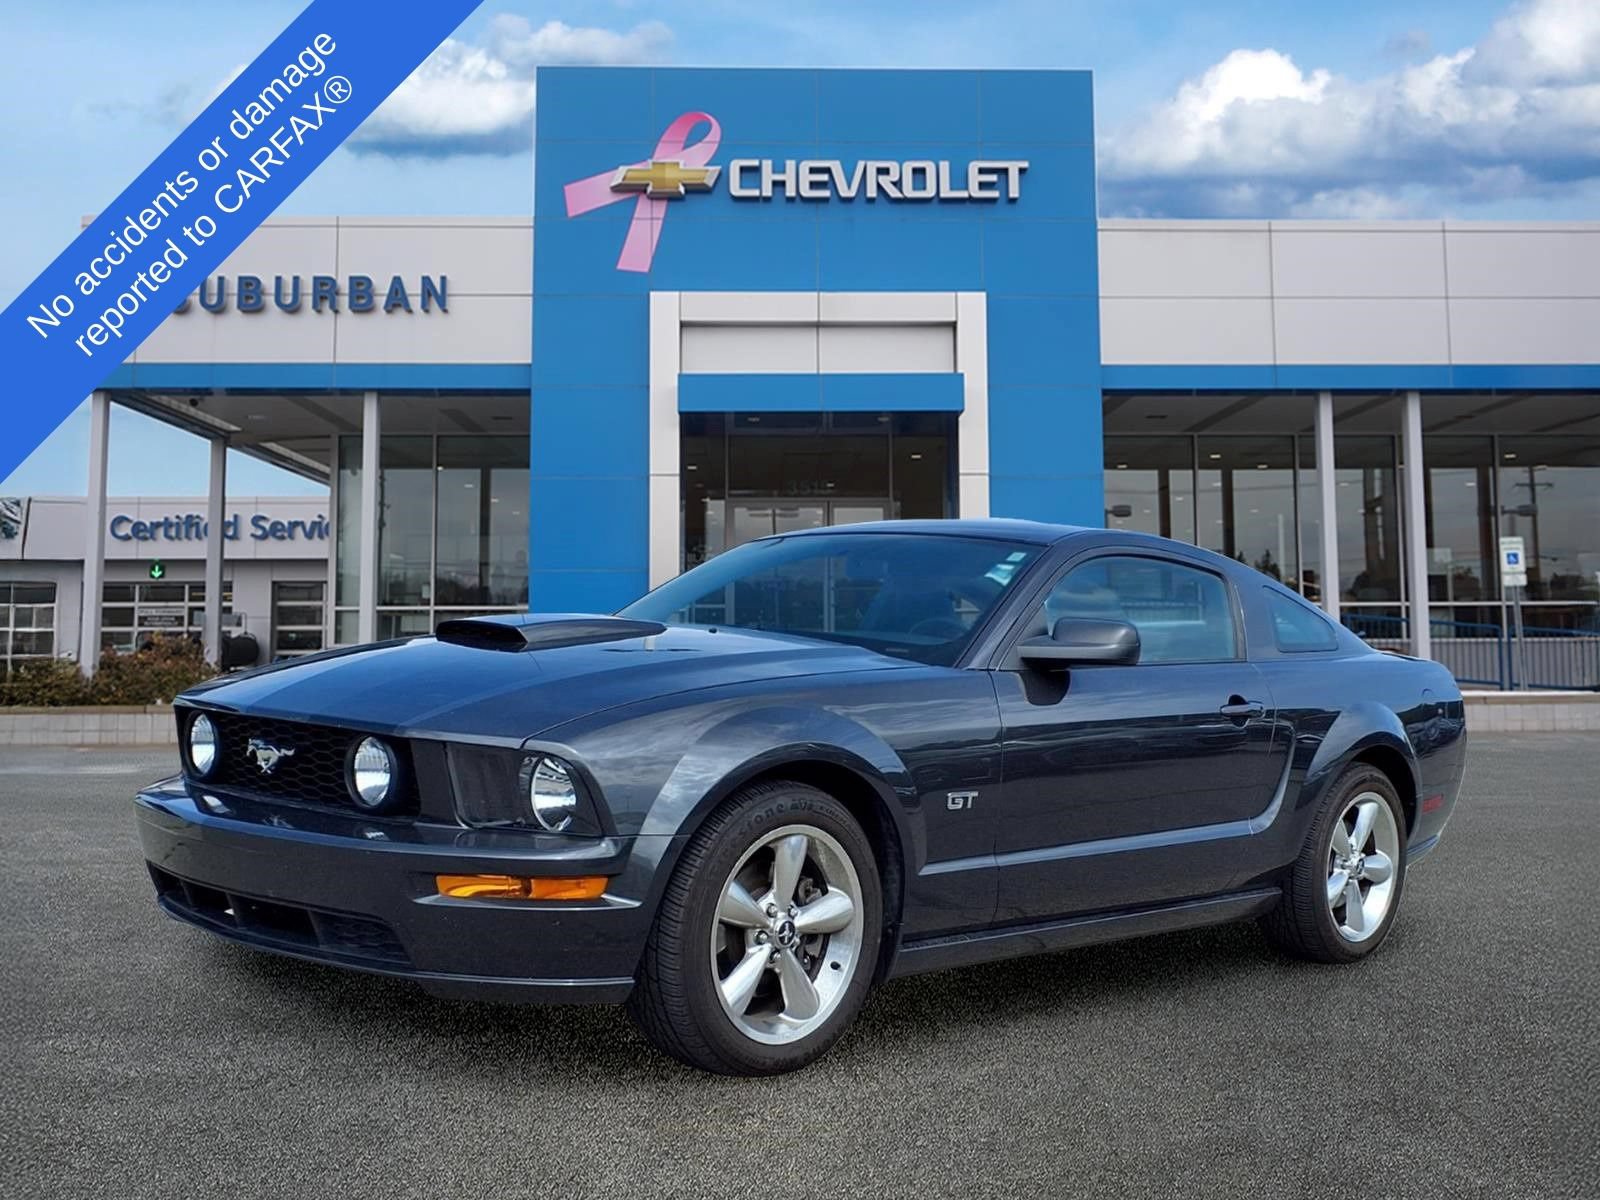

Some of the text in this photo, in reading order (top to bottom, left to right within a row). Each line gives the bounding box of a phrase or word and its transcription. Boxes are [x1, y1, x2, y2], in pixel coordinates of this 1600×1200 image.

[729, 159, 1029, 199] CHEVROLET
[173, 275, 449, 312] UBURBAN
[947, 791, 979, 810] GT
